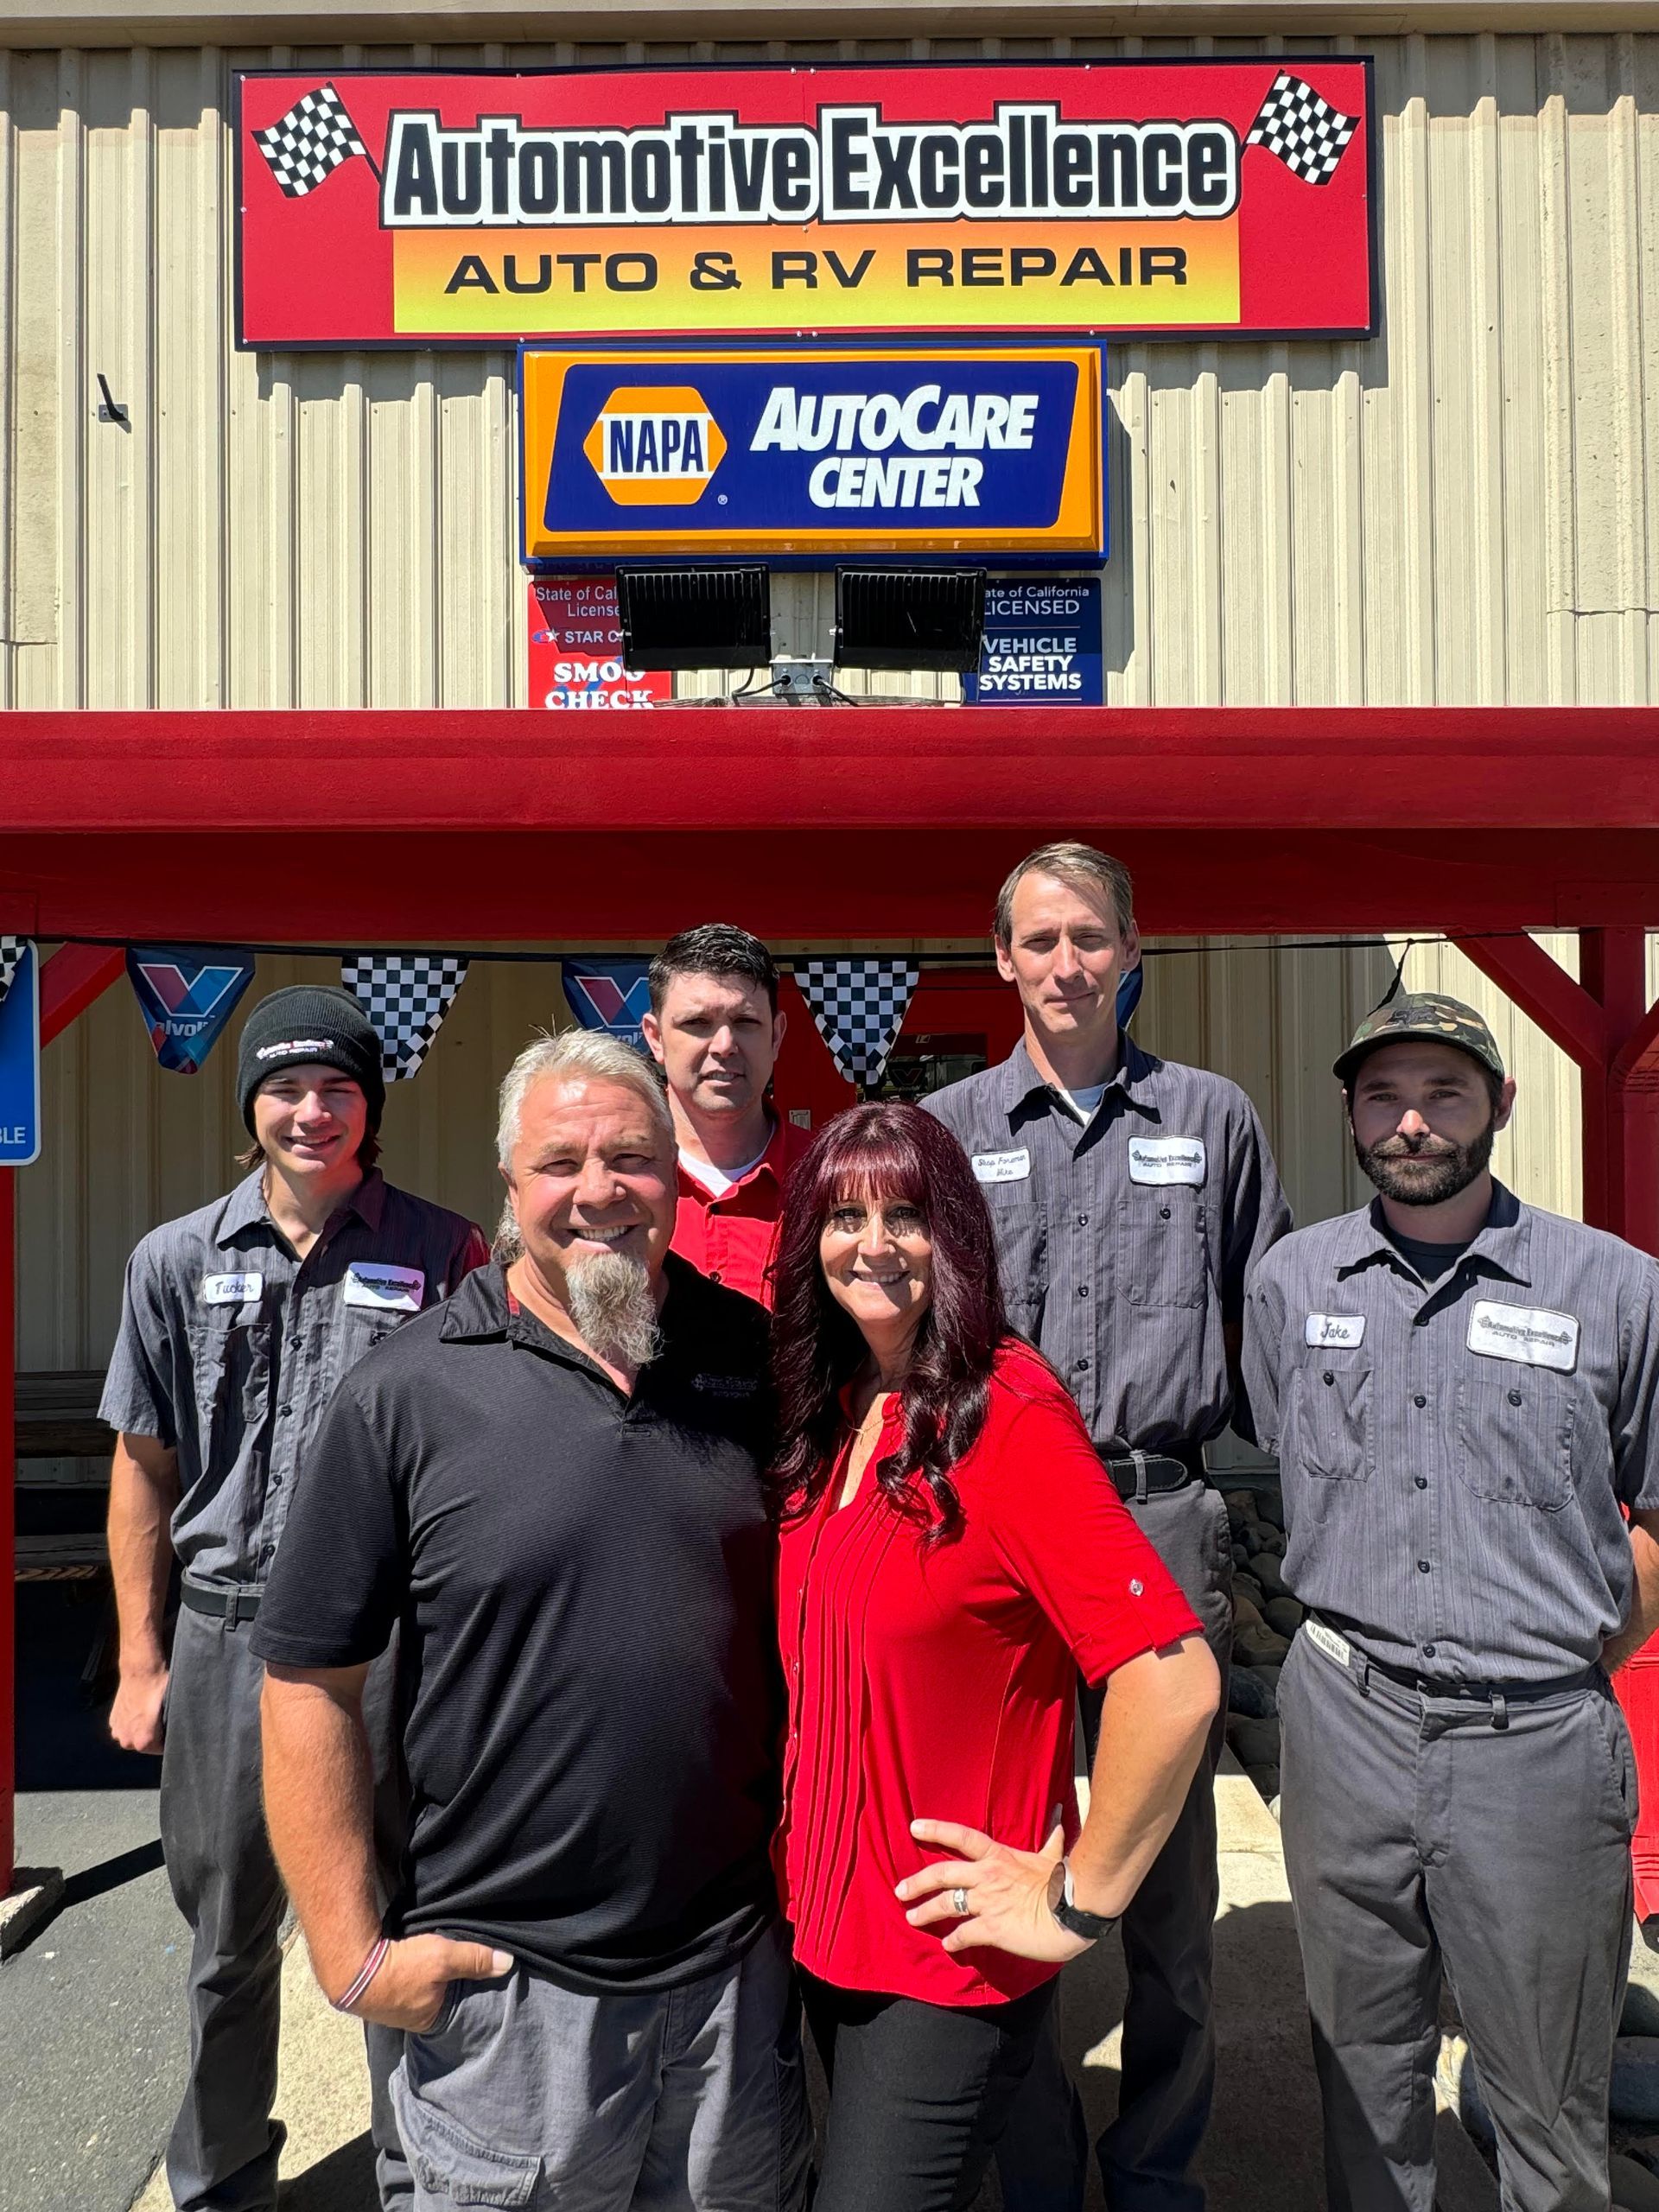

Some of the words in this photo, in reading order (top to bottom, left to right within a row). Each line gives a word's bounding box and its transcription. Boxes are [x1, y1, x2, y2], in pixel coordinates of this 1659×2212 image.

[391, 121, 813, 217] Automotive
[830, 113, 1229, 212] Excellence
[443, 252, 659, 295] AUTO
[690, 251, 742, 291] &
[771, 249, 877, 289] RV
[906, 246, 1188, 288] REPAIR
[608, 419, 705, 474] NAPA
[808, 456, 984, 508] CENTER
[537, 587, 572, 601] State
[576, 587, 591, 601] of
[985, 588, 1005, 598] ate
[1008, 587, 1023, 598] of
[1027, 586, 1090, 598] California
[564, 631, 604, 644] STAR
[982, 637, 1077, 654] VEHICLE
[988, 655, 1073, 672] SAFETY
[979, 672, 1082, 690] SYSTEMS
[544, 690, 654, 709] CHECK
[215, 1281, 254, 1294] Tucker
[1320, 1322, 1350, 1342] Jake
[1491, 1331, 1517, 1340] AUTO
